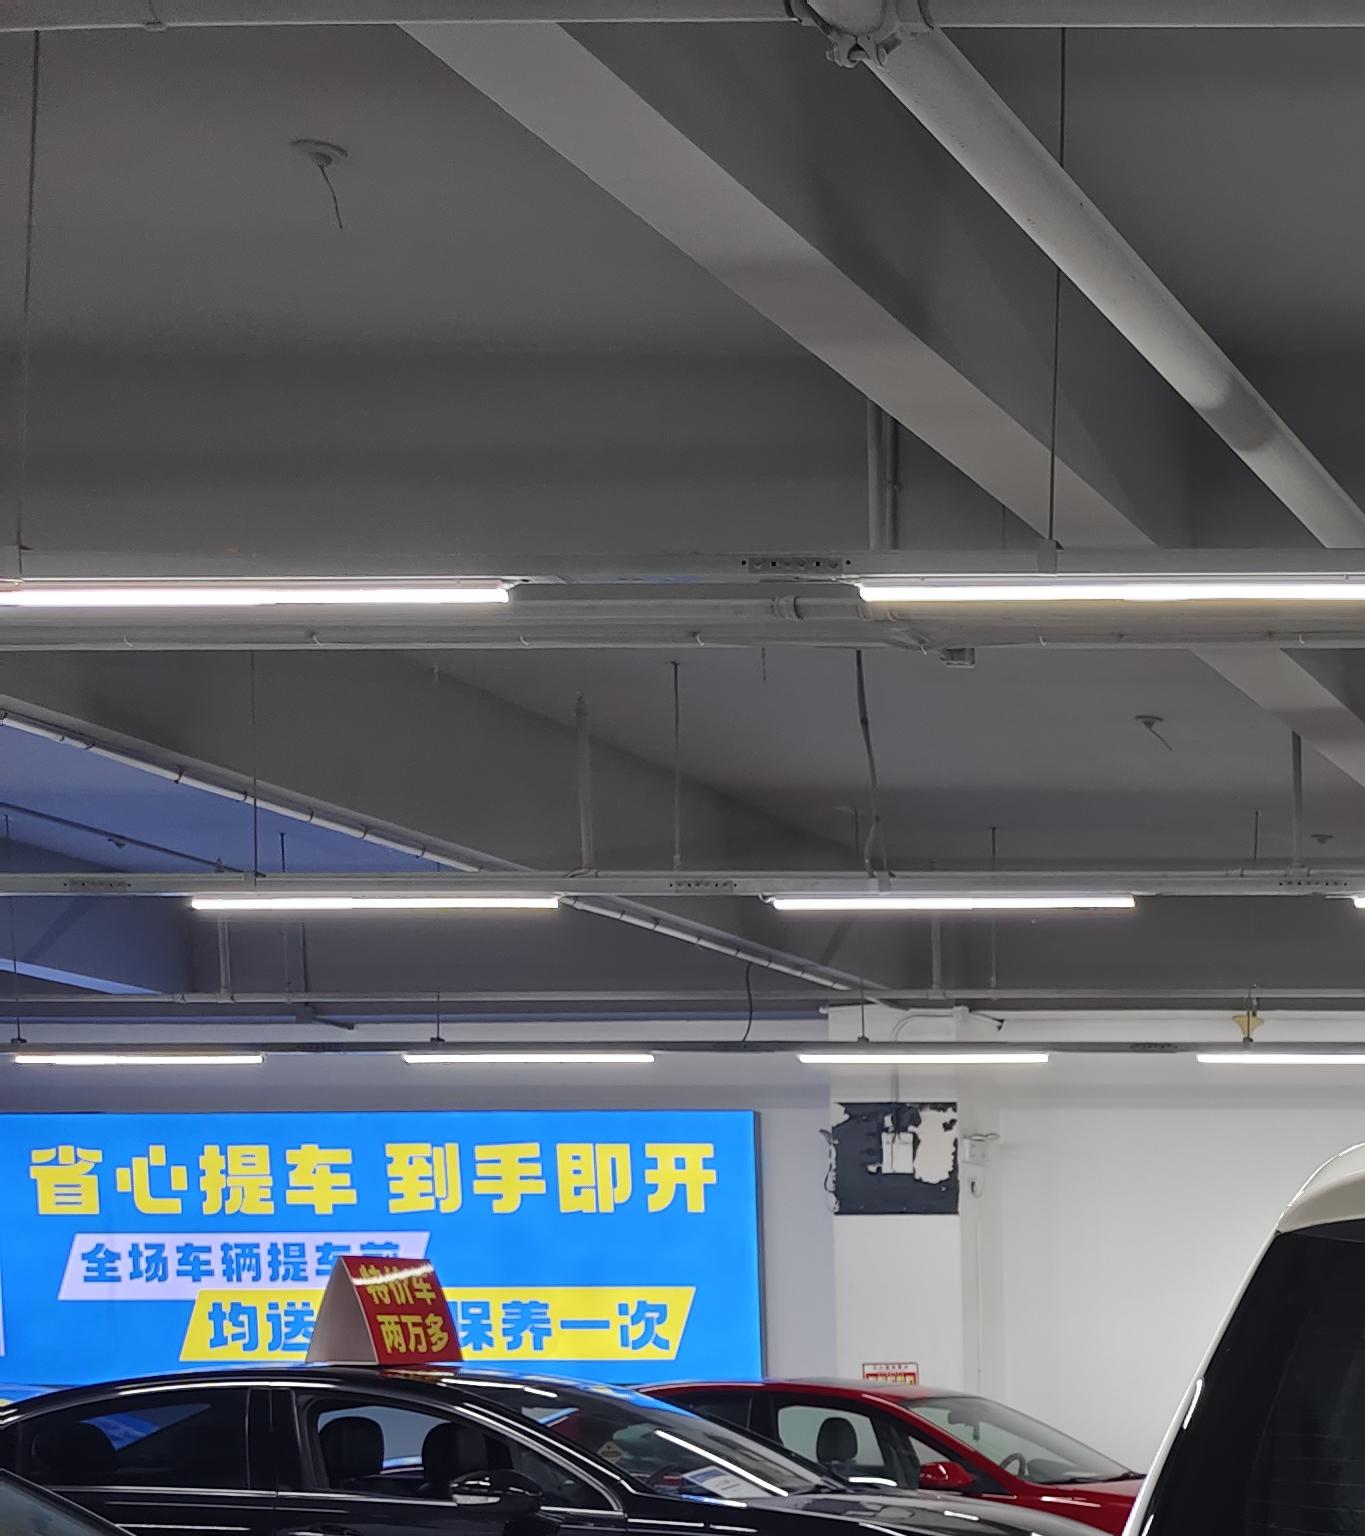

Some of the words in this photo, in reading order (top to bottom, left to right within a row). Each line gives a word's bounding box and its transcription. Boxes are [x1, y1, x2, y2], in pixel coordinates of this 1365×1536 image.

[29, 1143, 358, 1215] 省心提车
[384, 1141, 718, 1214] 到手即开
[376, 1312, 449, 1354] 两万多
